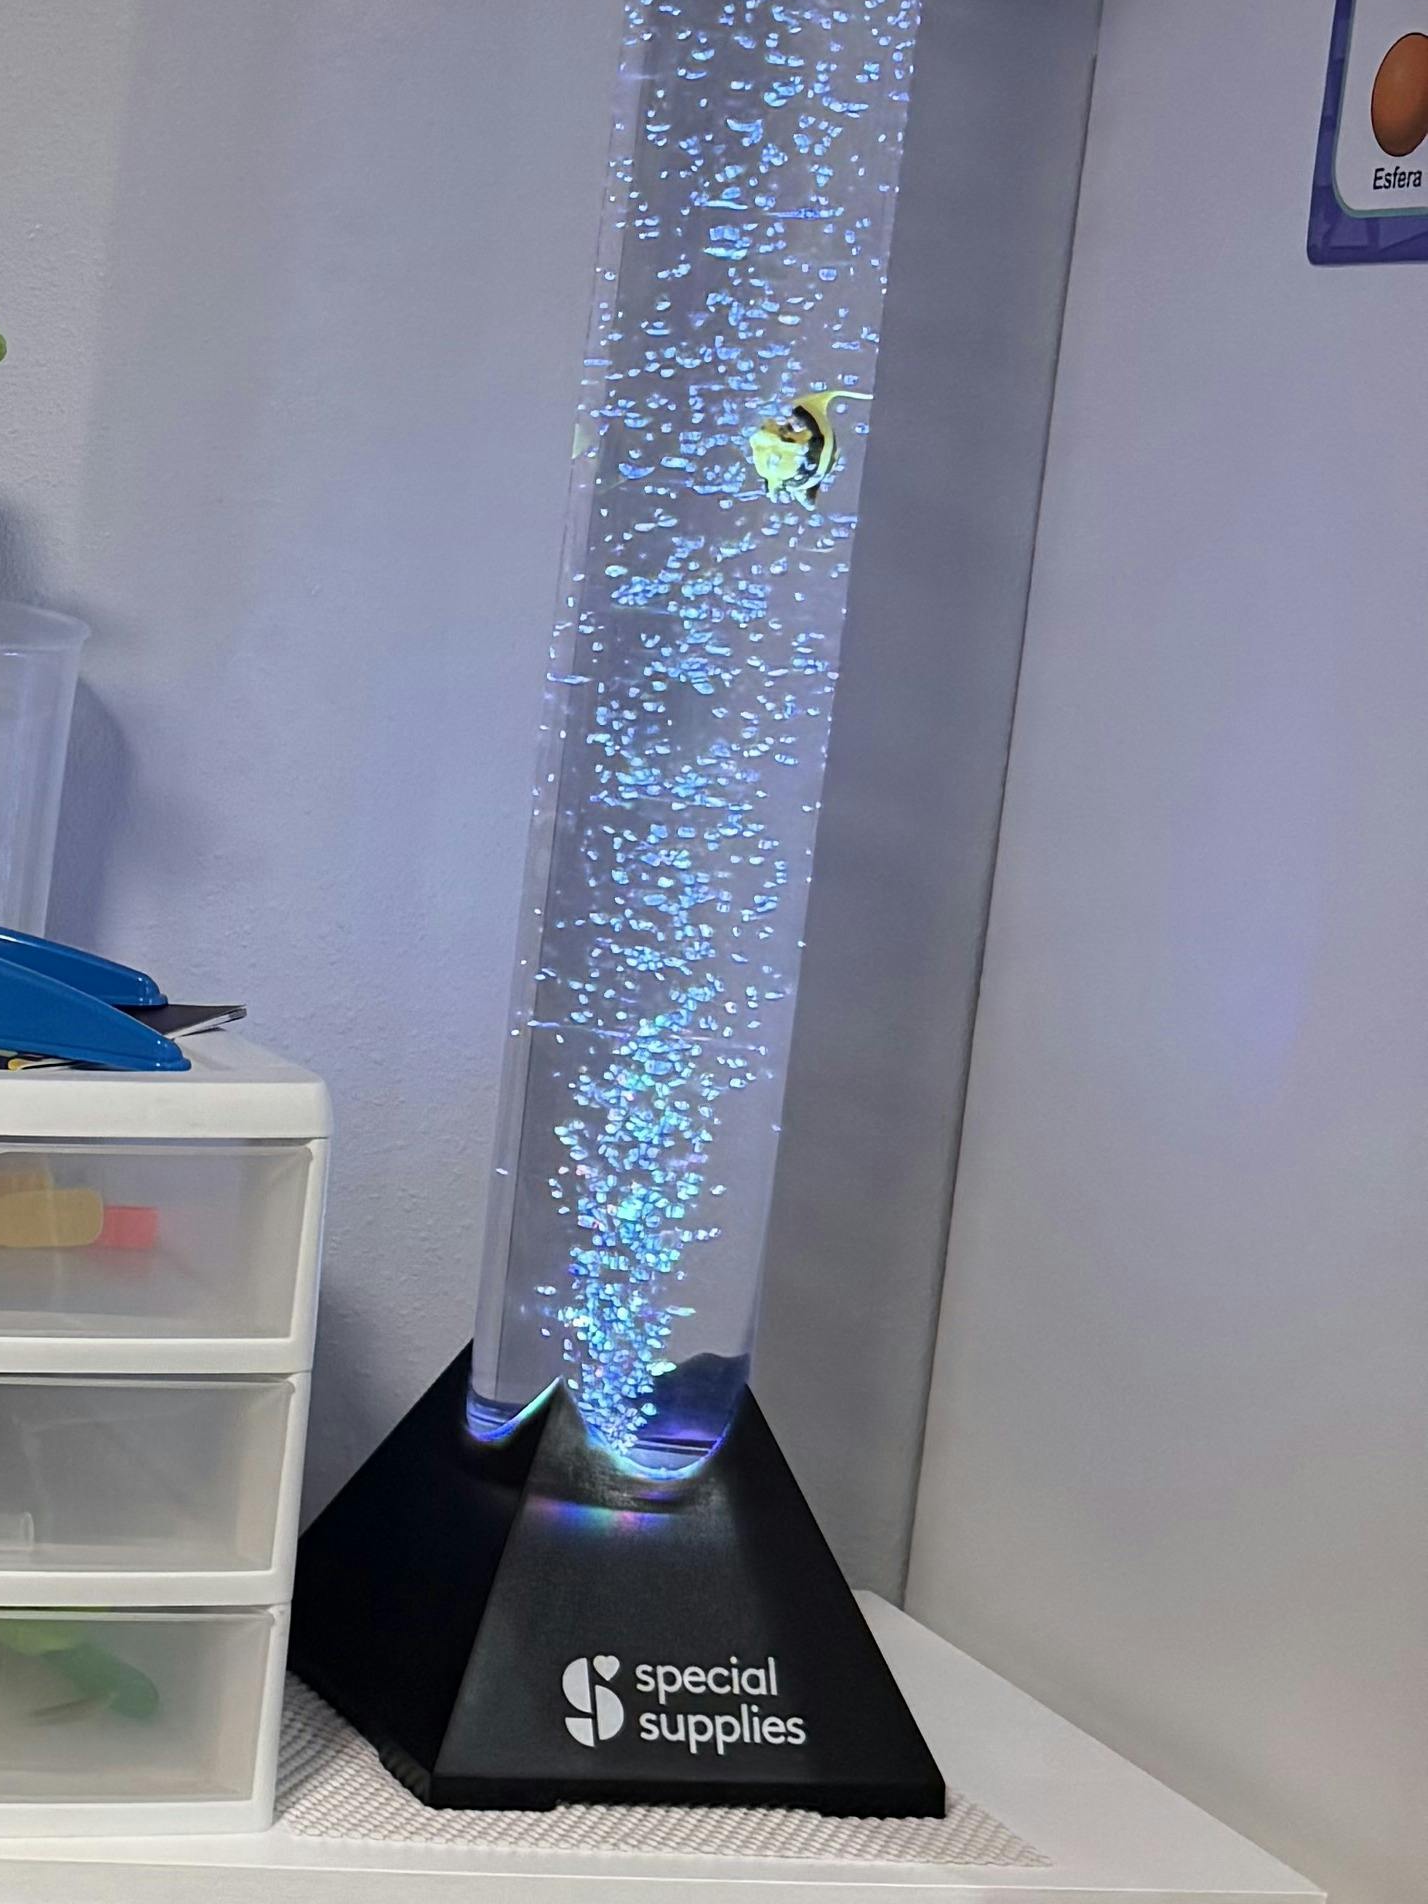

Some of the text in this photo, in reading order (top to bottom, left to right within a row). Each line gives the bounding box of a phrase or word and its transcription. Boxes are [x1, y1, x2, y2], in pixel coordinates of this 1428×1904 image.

[1373, 165, 1422, 190] Esfera
[635, 1656, 778, 1705] special
[639, 1703, 807, 1755] supplies
